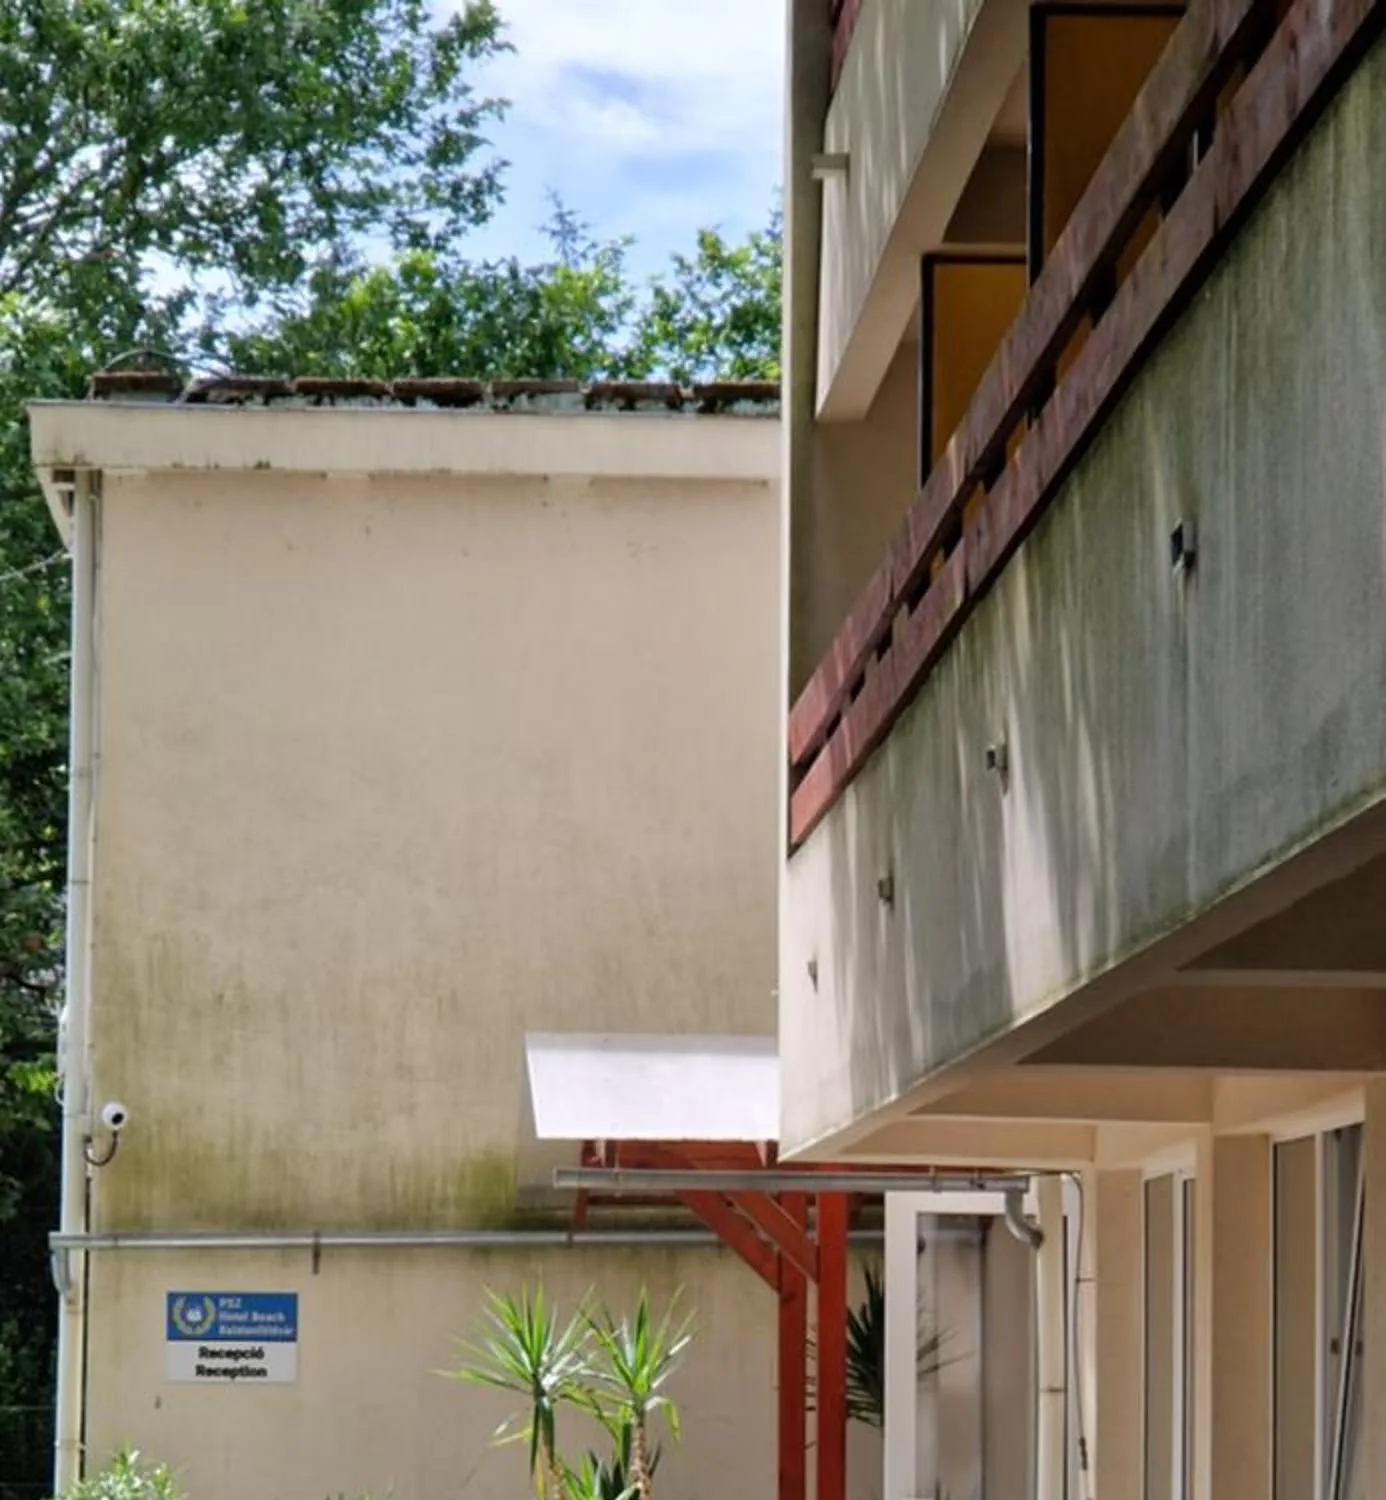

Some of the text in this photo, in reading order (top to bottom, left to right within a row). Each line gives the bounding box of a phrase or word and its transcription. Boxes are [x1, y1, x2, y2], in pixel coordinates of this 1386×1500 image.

[219, 1311, 286, 1323] Hotel Beach
[198, 1346, 265, 1361] Recepció
[195, 1364, 268, 1380] Reception
